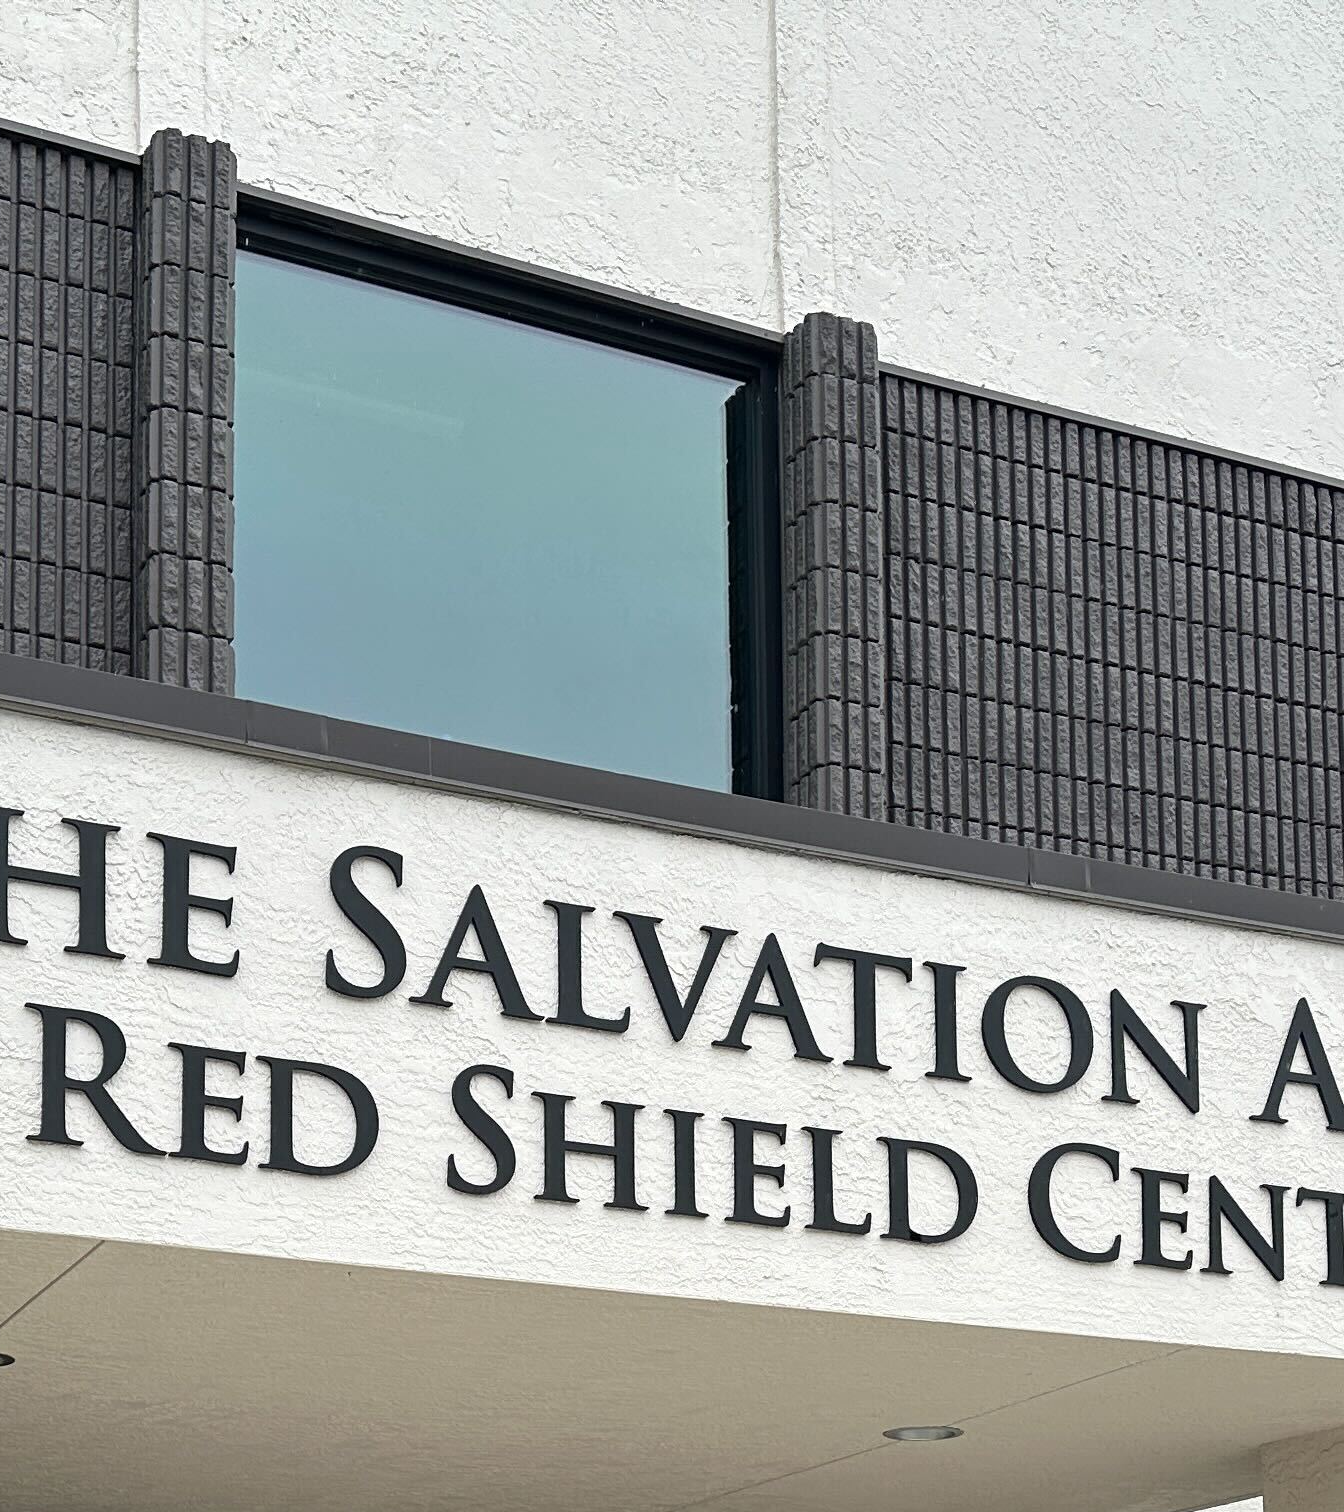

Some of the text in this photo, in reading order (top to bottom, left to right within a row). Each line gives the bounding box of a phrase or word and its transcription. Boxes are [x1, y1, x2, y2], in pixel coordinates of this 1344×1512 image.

[325, 845, 1208, 1116] SALVATION
[24, 1002, 380, 1178] RED
[446, 1063, 979, 1246] SHIELD
